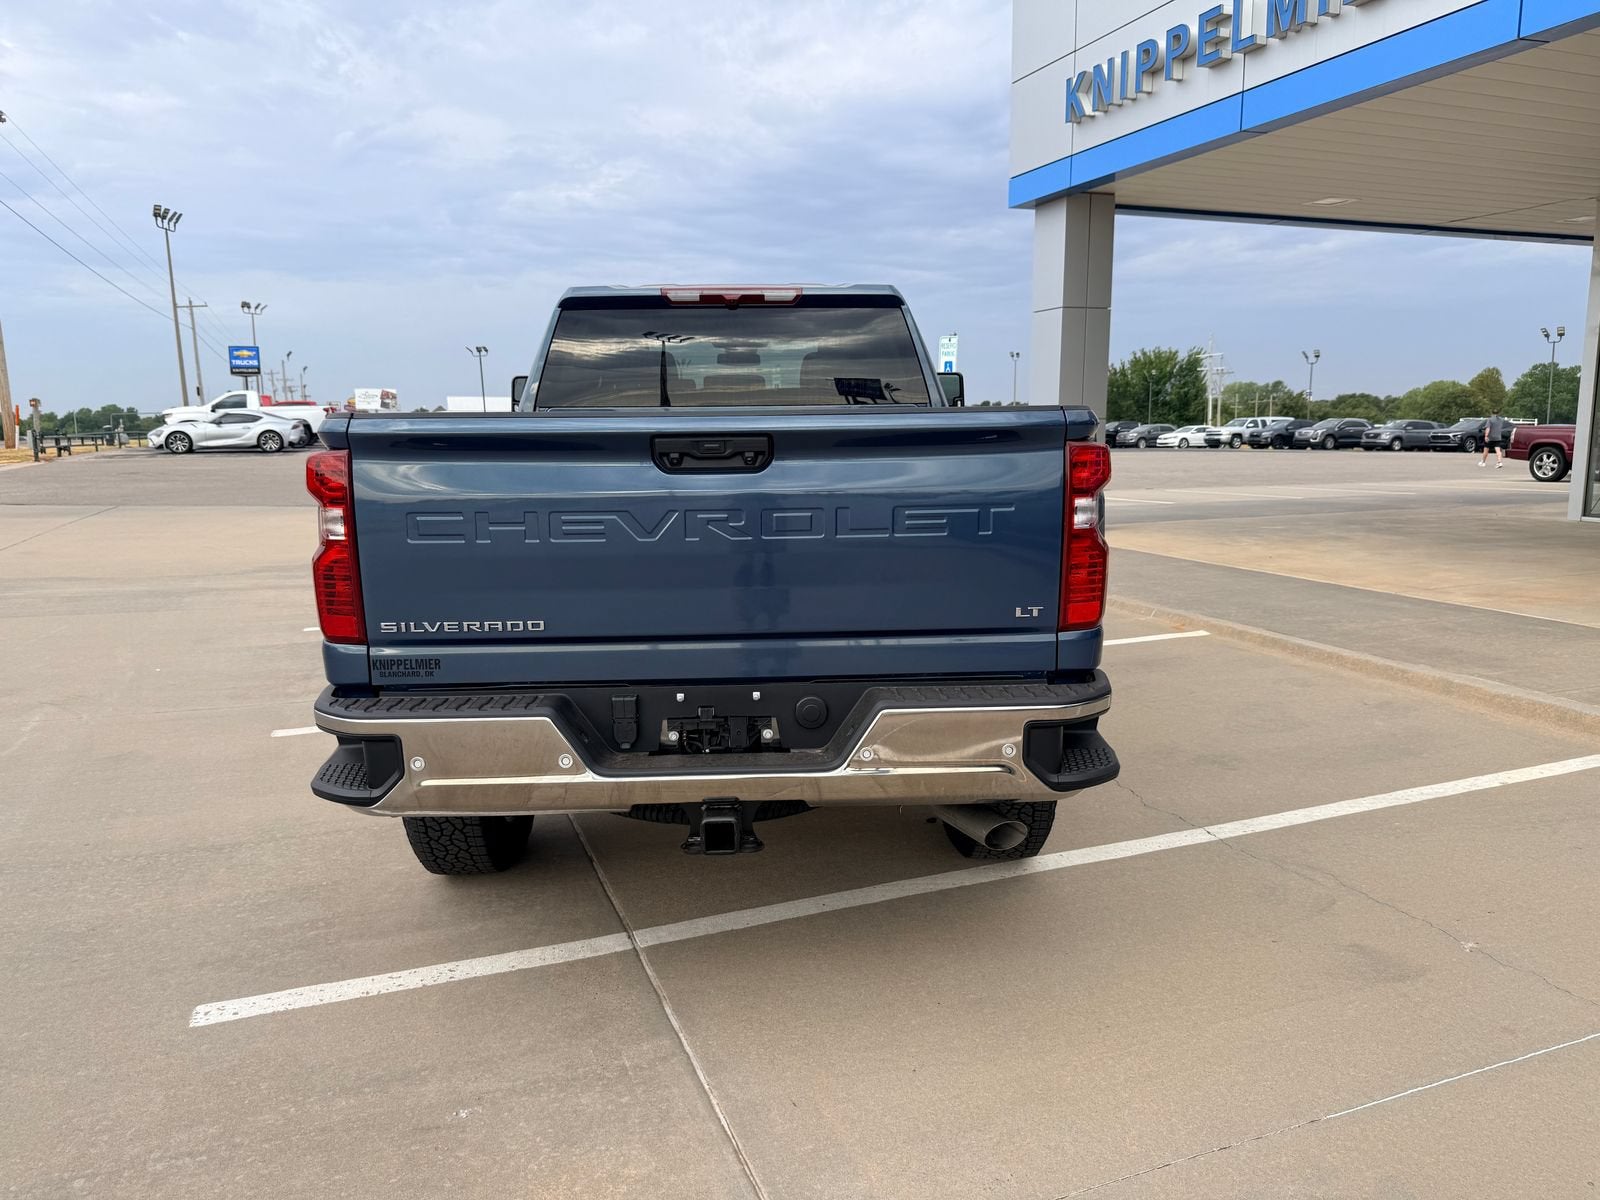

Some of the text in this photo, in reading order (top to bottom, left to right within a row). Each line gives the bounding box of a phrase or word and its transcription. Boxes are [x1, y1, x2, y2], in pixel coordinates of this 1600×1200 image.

[406, 503, 1016, 545] CHEVROLET
[1015, 606, 1044, 618] LT
[380, 620, 546, 633] SILVERADO
[372, 658, 441, 671] KNIPPELMIER
[379, 670, 435, 678] BLANCHARD, OK
